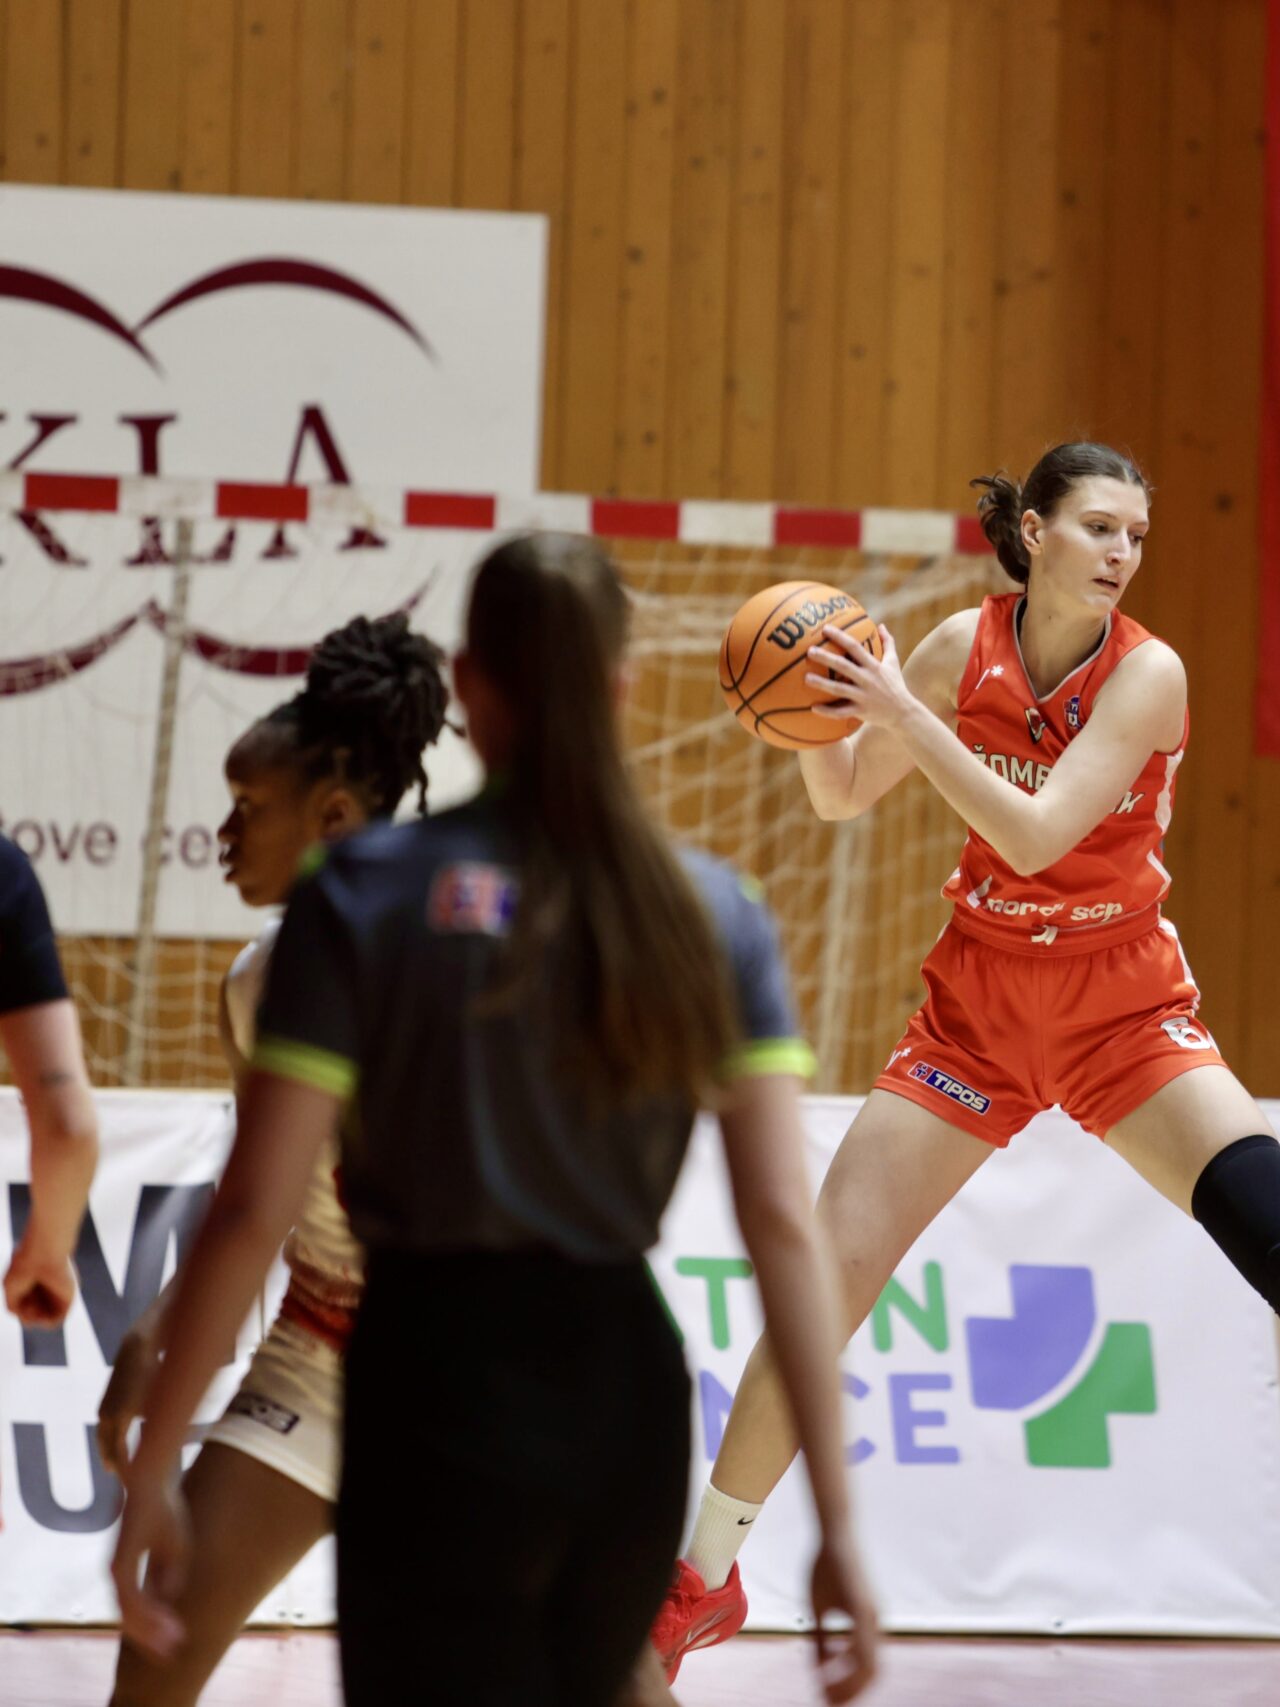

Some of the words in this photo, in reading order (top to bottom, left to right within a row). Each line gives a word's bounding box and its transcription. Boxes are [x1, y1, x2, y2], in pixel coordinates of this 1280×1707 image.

[0, 814, 117, 867] ove
[1070, 903, 1123, 922] scp
[934, 1072, 986, 1110] TIPOS
